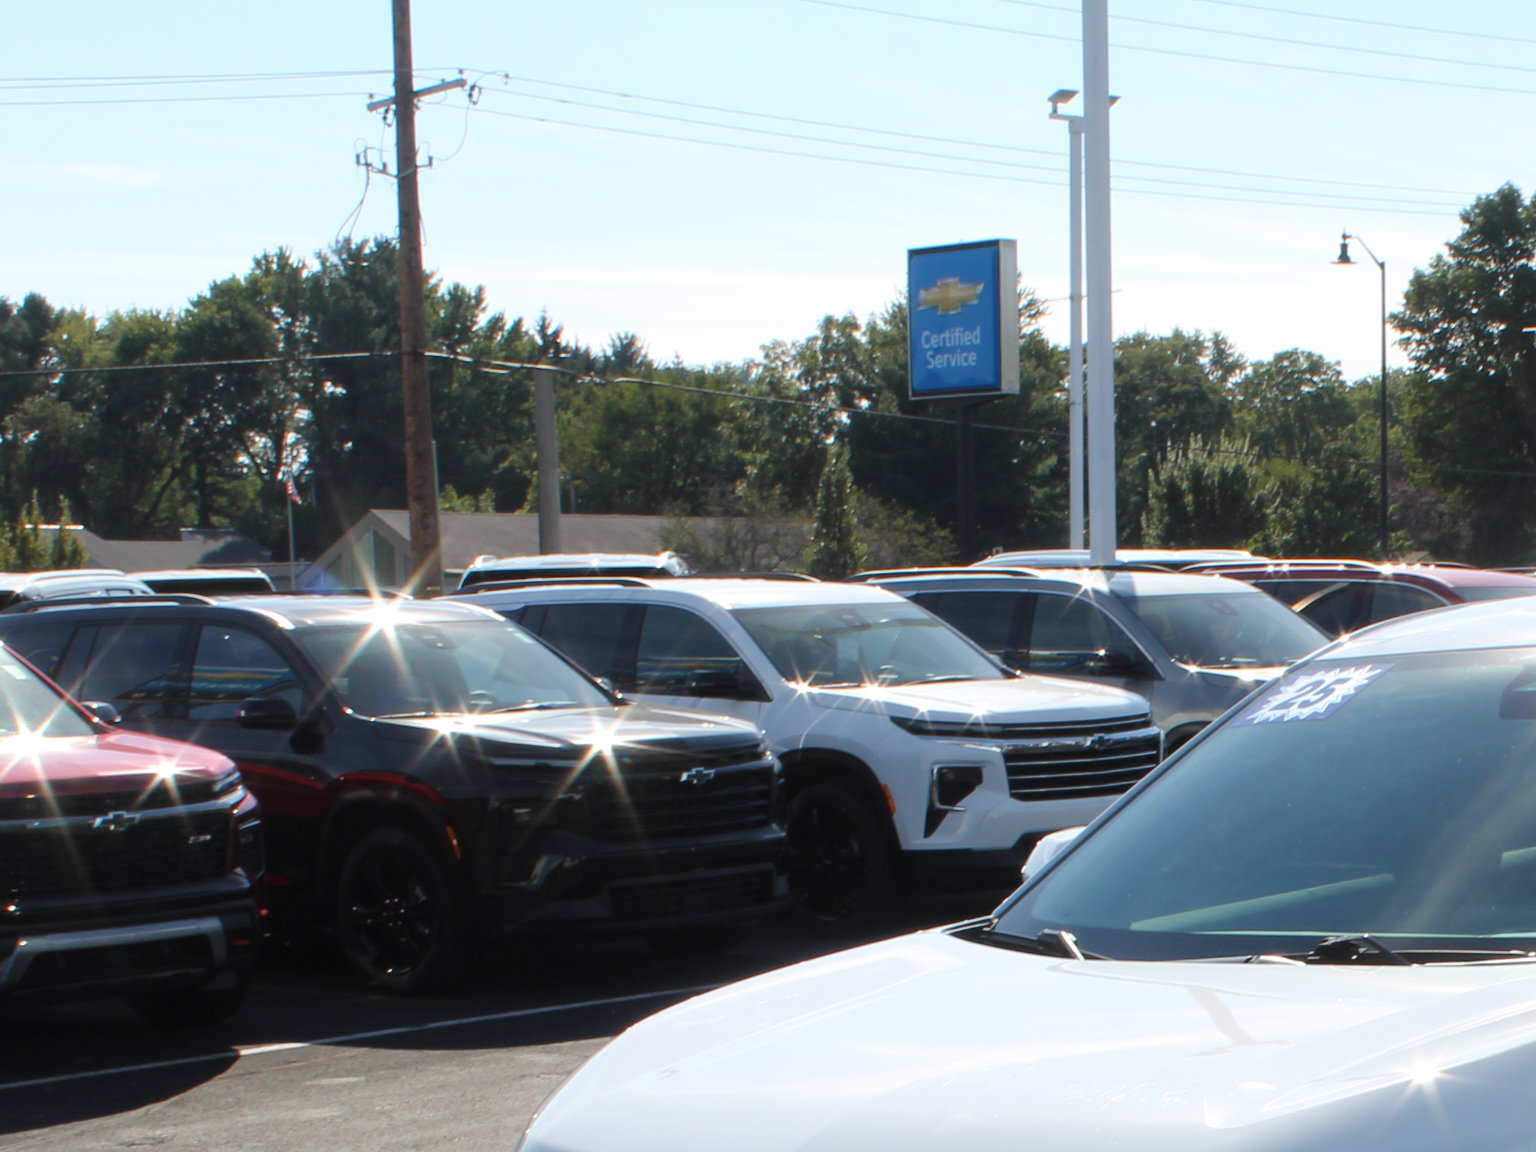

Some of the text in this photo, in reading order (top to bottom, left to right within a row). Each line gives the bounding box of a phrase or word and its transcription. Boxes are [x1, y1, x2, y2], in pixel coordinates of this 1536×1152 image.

[921, 325, 981, 349] Certified
[926, 349, 977, 369] Service
[1267, 677, 1353, 710] 25
